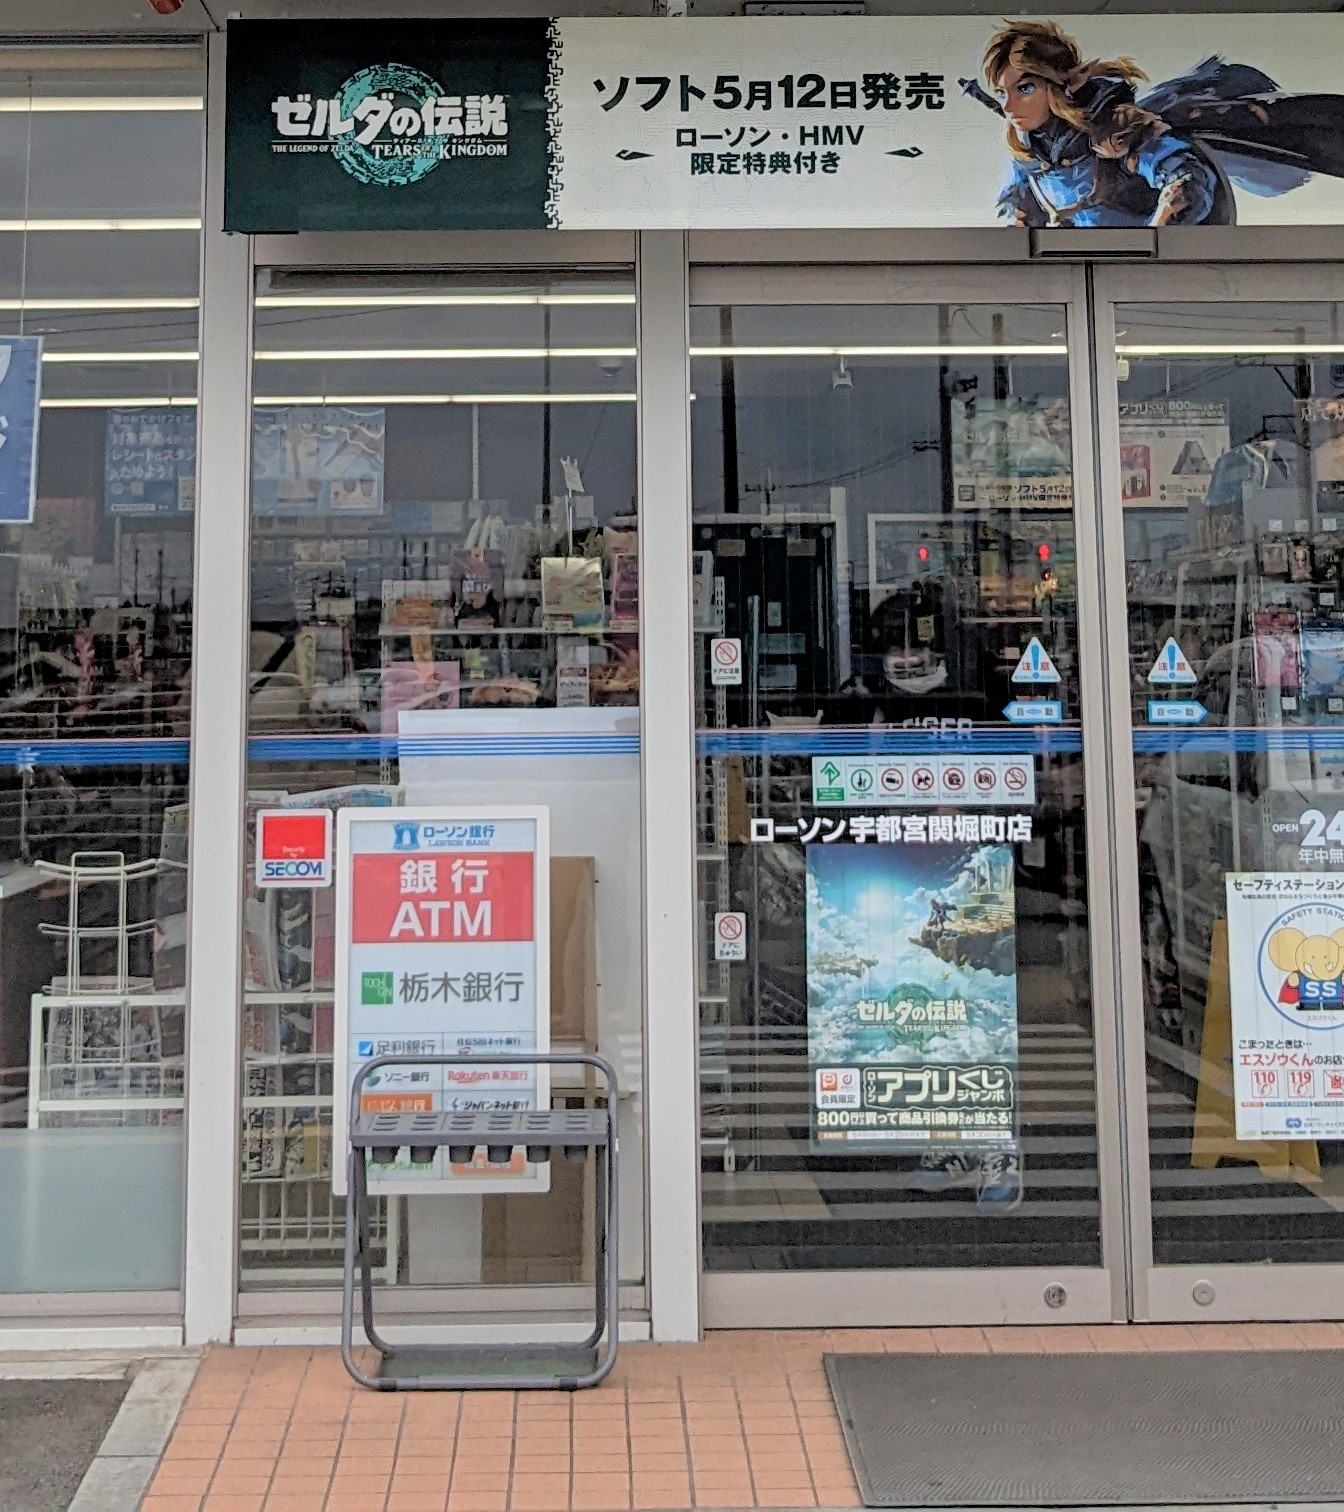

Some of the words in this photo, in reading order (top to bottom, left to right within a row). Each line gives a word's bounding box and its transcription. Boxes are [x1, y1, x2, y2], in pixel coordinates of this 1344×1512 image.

[594, 73, 946, 112] ソフト5月12日発売
[271, 93, 508, 146] ゼルダの伝説
[289, 145, 318, 154] LEGEND
[372, 144, 420, 160] TEARS
[438, 144, 508, 160] KINGDOM
[690, 152, 841, 177] 限定特典付き
[423, 824, 496, 839] ローソン銀行
[1272, 823, 1299, 833] OPEN
[466, 839, 491, 847] BANK
[264, 861, 323, 877] SECOM
[399, 858, 490, 895] 銀行
[389, 900, 493, 938] ATM
[1281, 907, 1313, 927] SAFETY
[398, 971, 525, 1004] 栃木銀行
[1305, 981, 1337, 998] SS
[856, 999, 968, 1026] ゼルダの伝説
[384, 1071, 430, 1083] ソニー銀行
[447, 1070, 490, 1083] Rakuten
[1253, 1071, 1276, 1084] 110
[1289, 1071, 1312, 1084] 119
[877, 1069, 1006, 1103] アプリくじ
[957, 1089, 1006, 1102] ジャンボ
